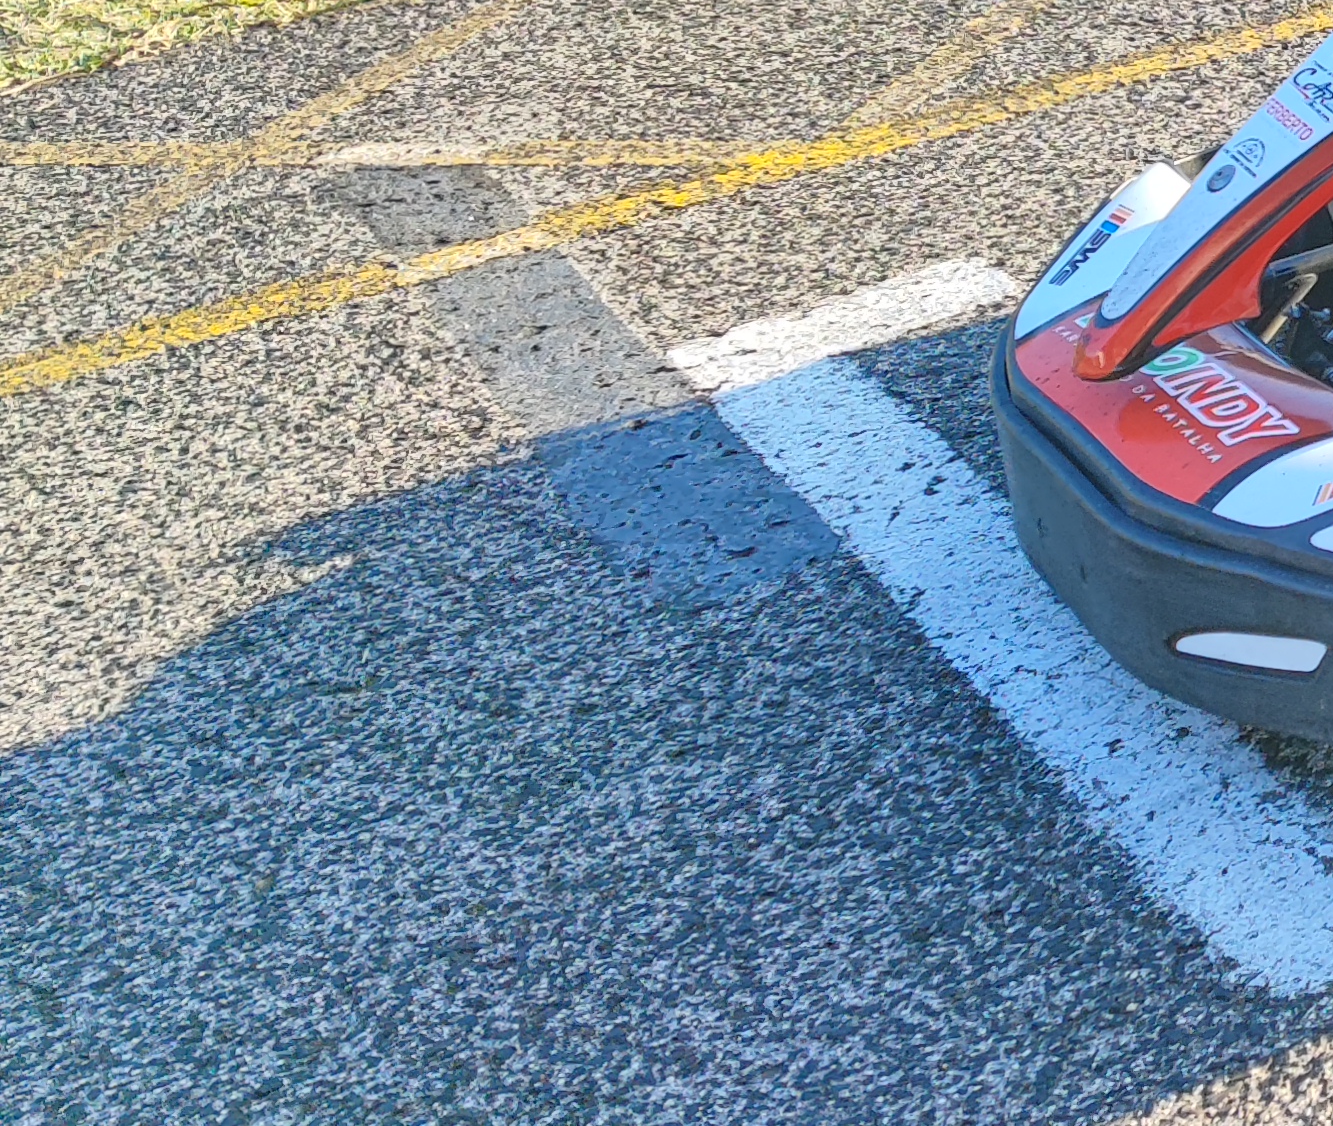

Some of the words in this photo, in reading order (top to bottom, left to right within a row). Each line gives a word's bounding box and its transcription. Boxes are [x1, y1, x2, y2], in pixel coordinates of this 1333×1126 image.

[1265, 97, 1315, 141] FERBERTO
[1131, 383, 1156, 404] DA
[1153, 403, 1223, 465] BATALHA
